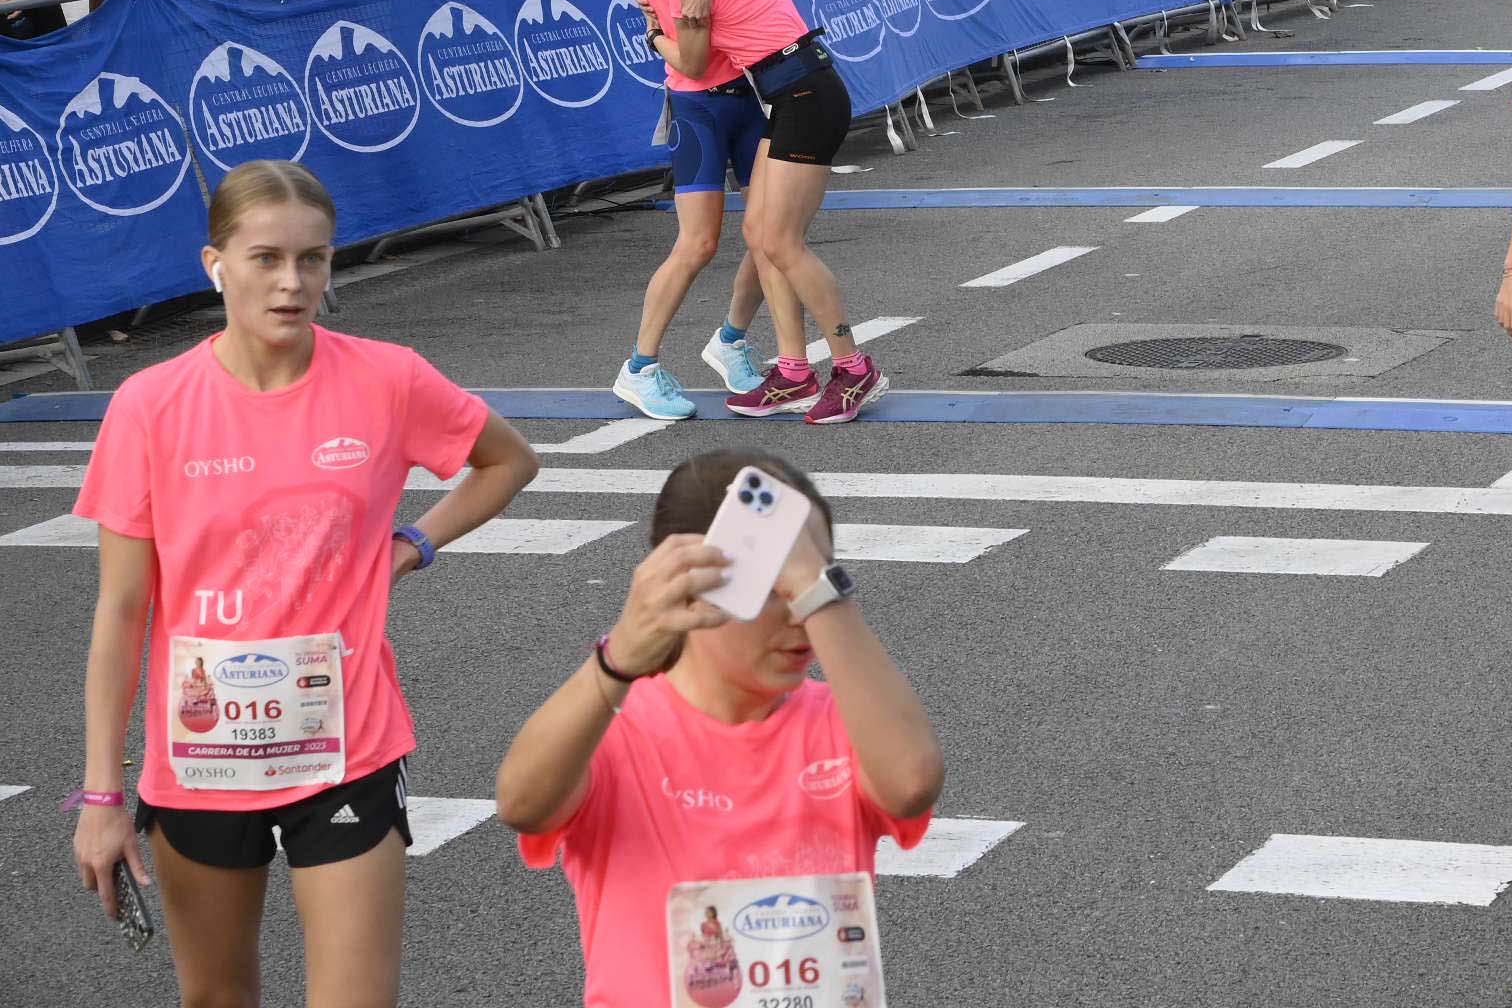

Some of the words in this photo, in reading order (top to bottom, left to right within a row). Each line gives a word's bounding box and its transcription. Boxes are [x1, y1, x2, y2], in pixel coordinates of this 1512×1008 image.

[531, 30, 560, 44] CENTRAL
[561, 25, 591, 38] LECHERA
[438, 45, 470, 60] CENTRAL
[472, 39, 504, 55] LECHERA
[522, 36, 608, 82] ASTURIANA
[325, 66, 361, 83] CENTRAL
[362, 58, 399, 75] LECHERA
[428, 52, 520, 100] ASTURIANA
[212, 89, 251, 106] CENTRAL
[252, 83, 288, 99] LECHERA
[314, 75, 415, 127] ASTURIANA
[80, 122, 123, 141] CENTRAL
[201, 98, 305, 152] ASTURIANA
[69, 127, 182, 189] ASTURIANA
[0, 157, 52, 201] RIANA
[185, 456, 255, 478] OYSHO
[196, 589, 244, 625] TU
[296, 655, 328, 666] SUMA
[218, 666, 284, 681] ASTURIANA
[224, 699, 282, 722] 016
[232, 727, 276, 741] 19383
[188, 746, 232, 757] CARRERA
[235, 746, 250, 755] DE
[253, 745, 263, 754] LA
[265, 744, 300, 754] MUJER
[185, 766, 236, 779] OYSHO
[278, 762, 332, 776] Santander
[330, 814, 360, 823] adidas
[742, 914, 822, 931] ASTURIANA
[749, 957, 820, 988] 016
